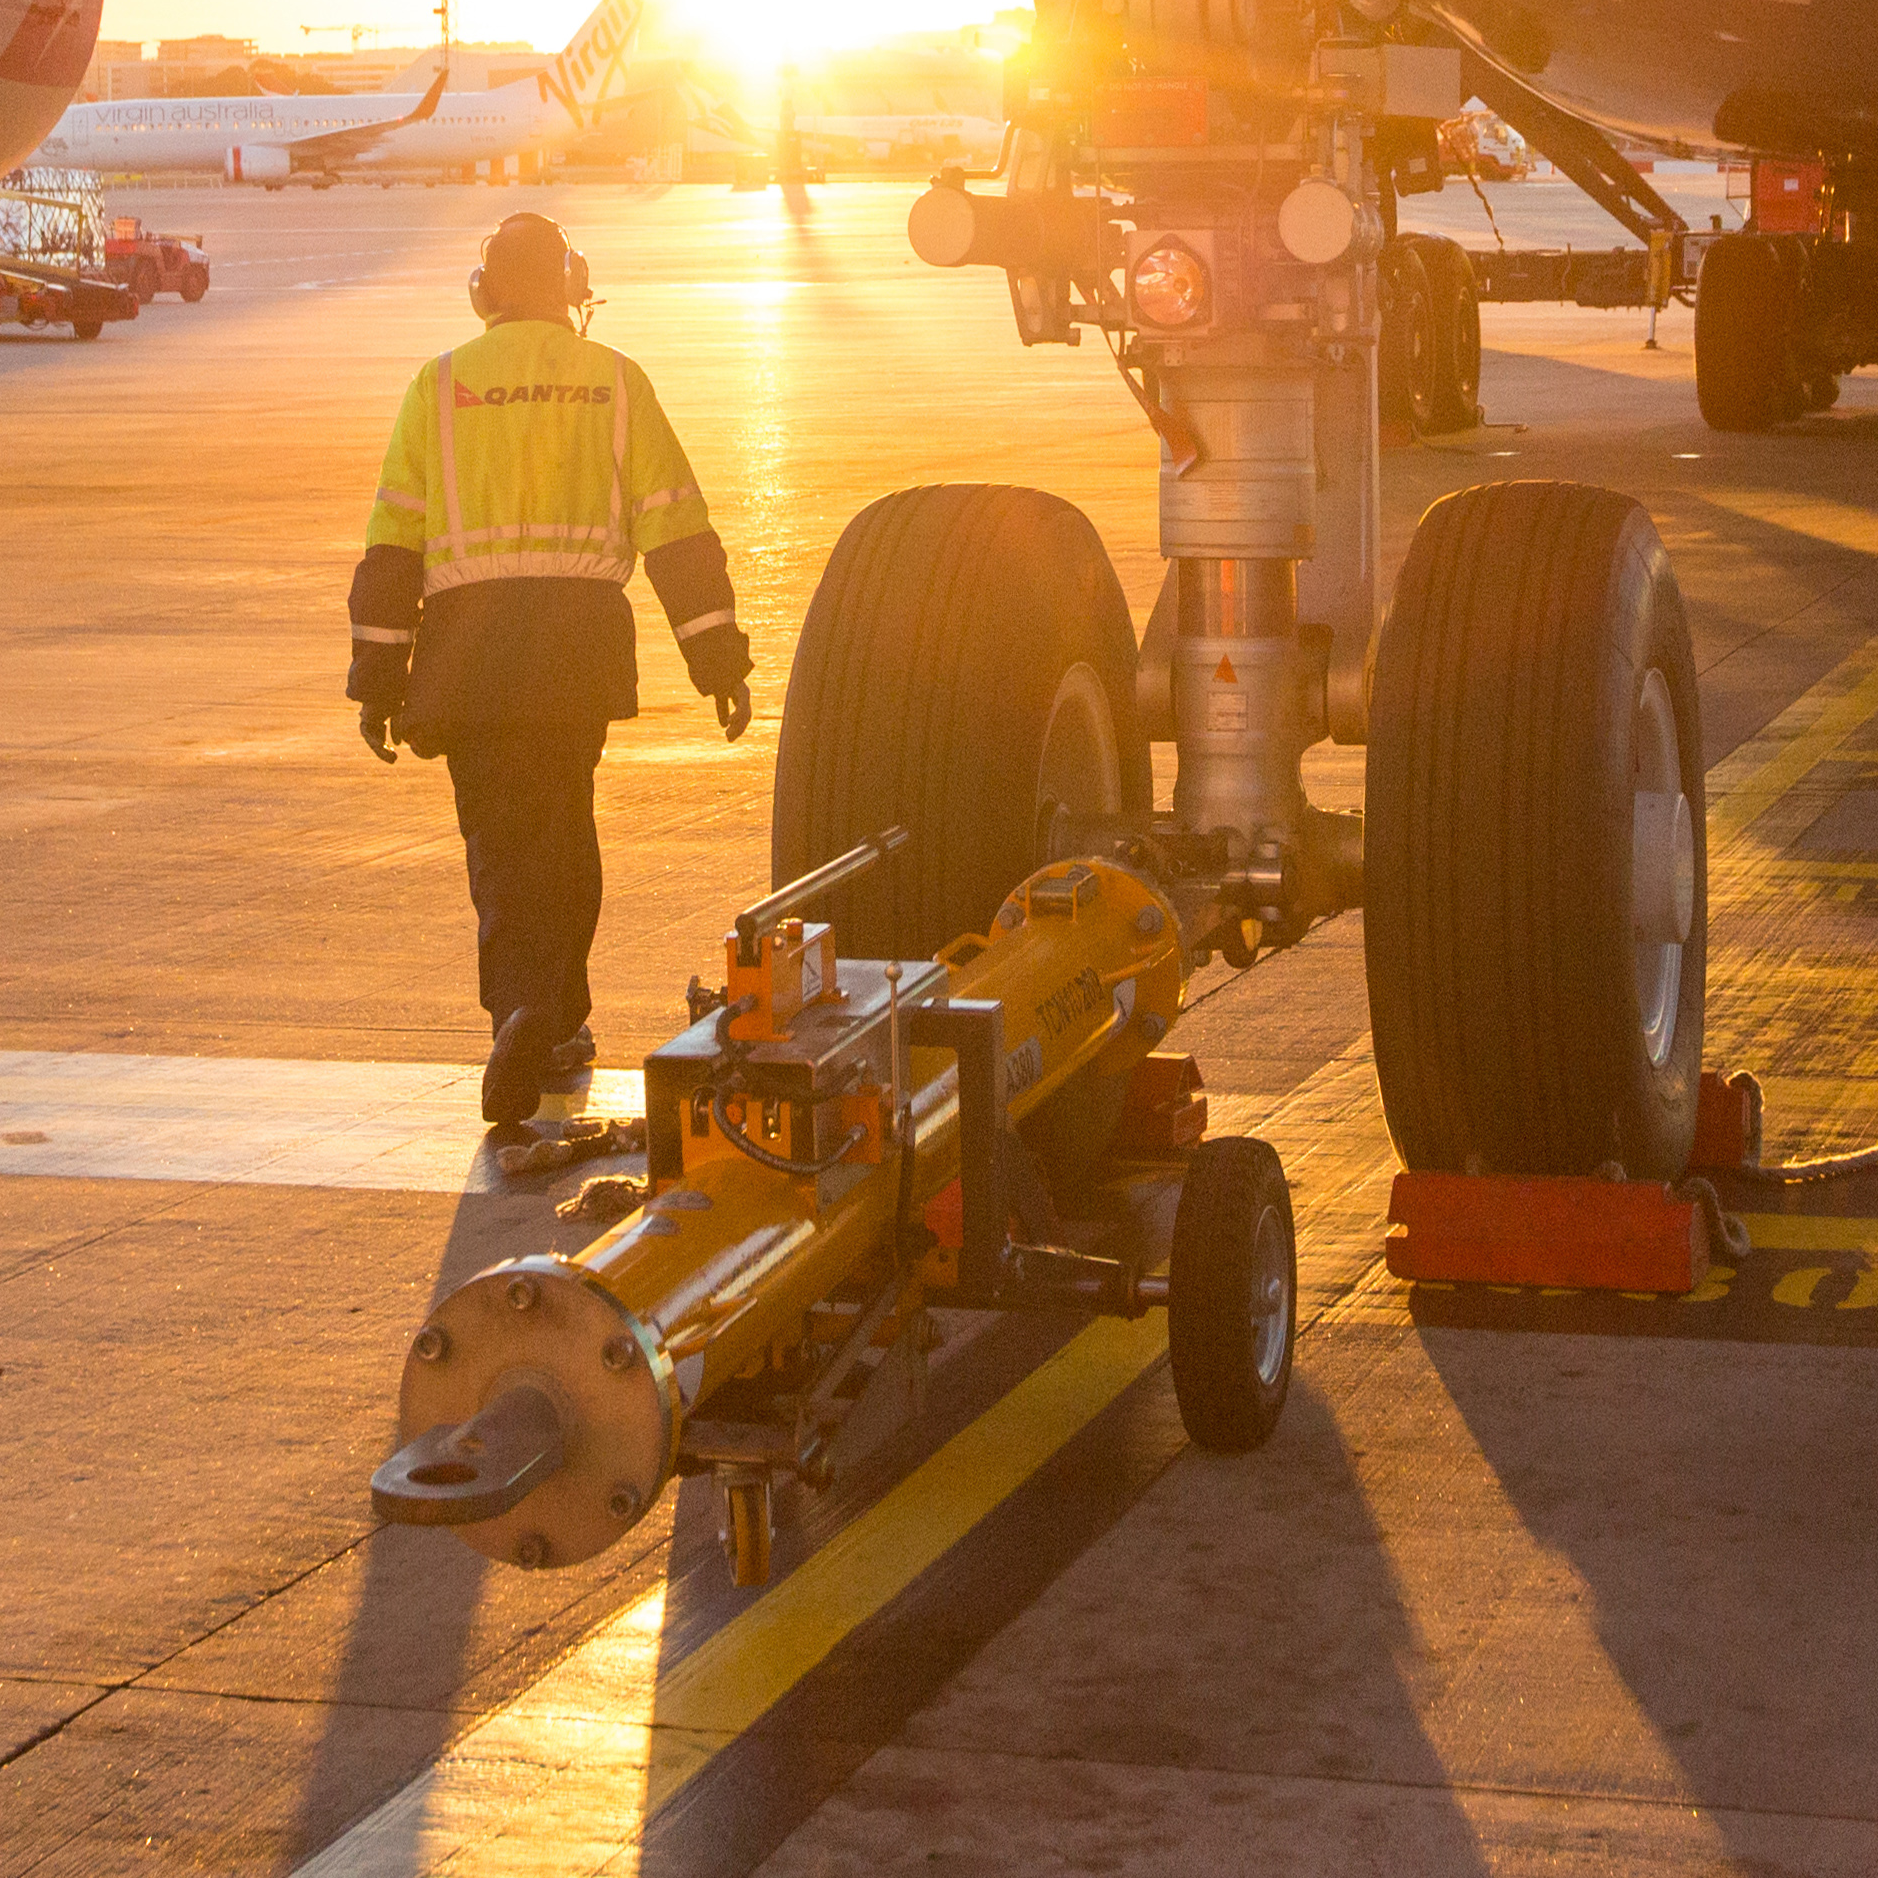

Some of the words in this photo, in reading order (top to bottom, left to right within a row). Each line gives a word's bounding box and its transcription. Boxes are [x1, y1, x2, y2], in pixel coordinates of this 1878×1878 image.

[94, 104, 166, 124] virgin
[171, 101, 275, 122] australia
[484, 384, 612, 407] QANTAS
